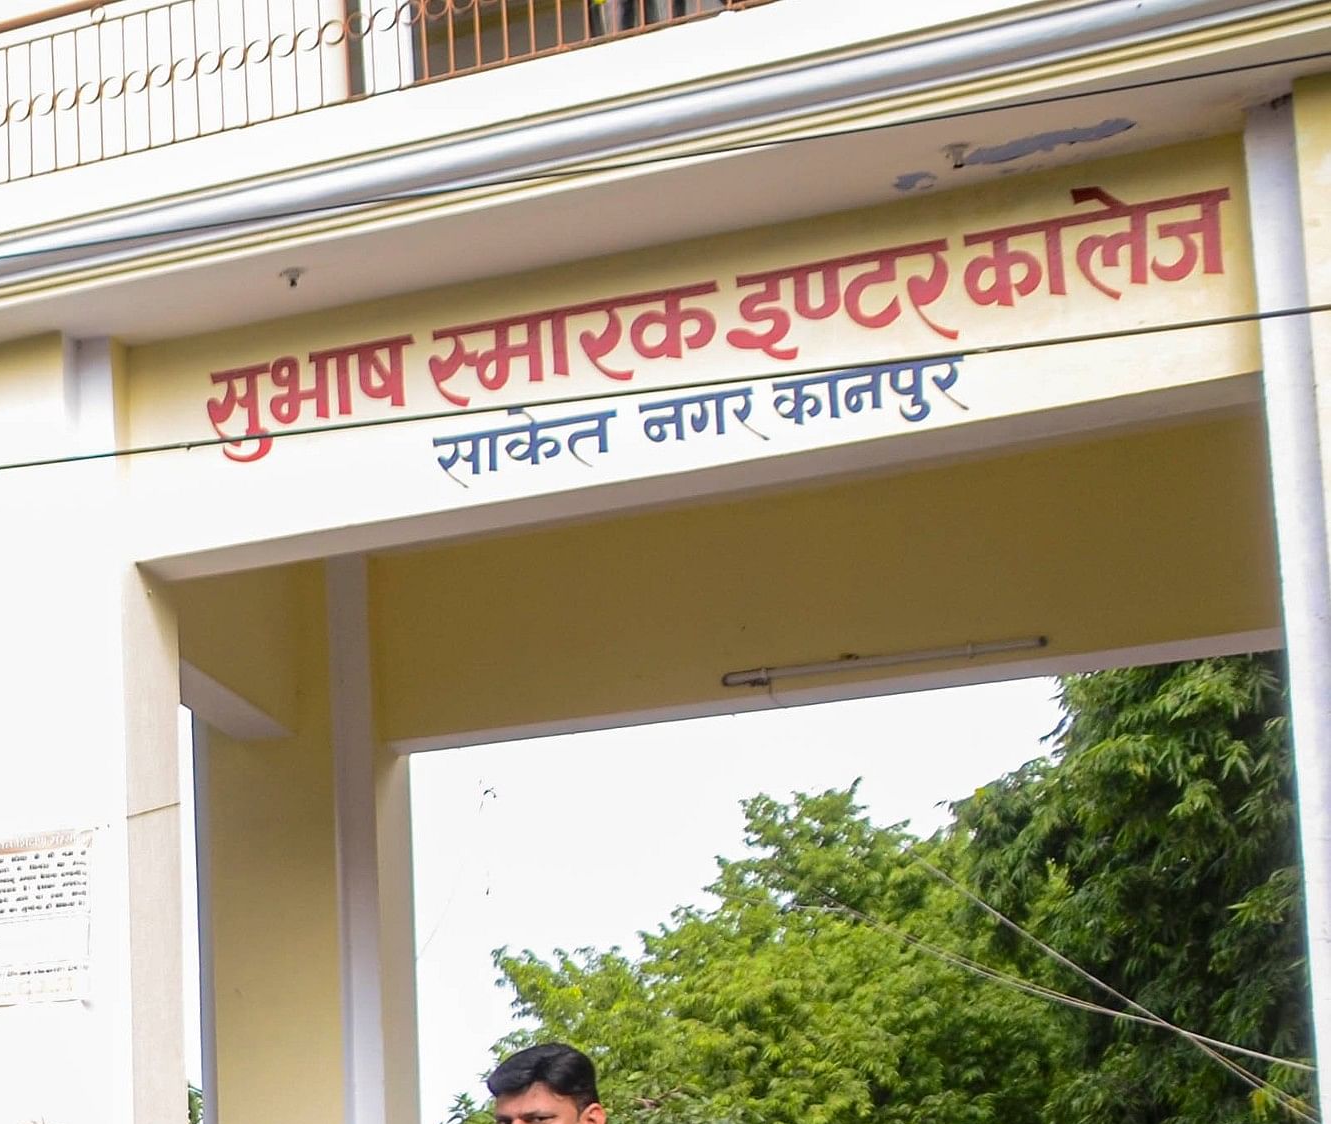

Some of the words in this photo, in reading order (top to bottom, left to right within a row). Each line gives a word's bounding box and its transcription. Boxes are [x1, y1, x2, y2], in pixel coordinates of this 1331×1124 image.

[206, 333, 414, 462] सुभाष
[429, 281, 718, 406] स्मारक
[726, 239, 958, 359] इण्टर
[963, 187, 1230, 306] कालेज
[433, 407, 617, 488] साकेत
[639, 387, 770, 440] नगर
[773, 357, 967, 425] कानपुर
